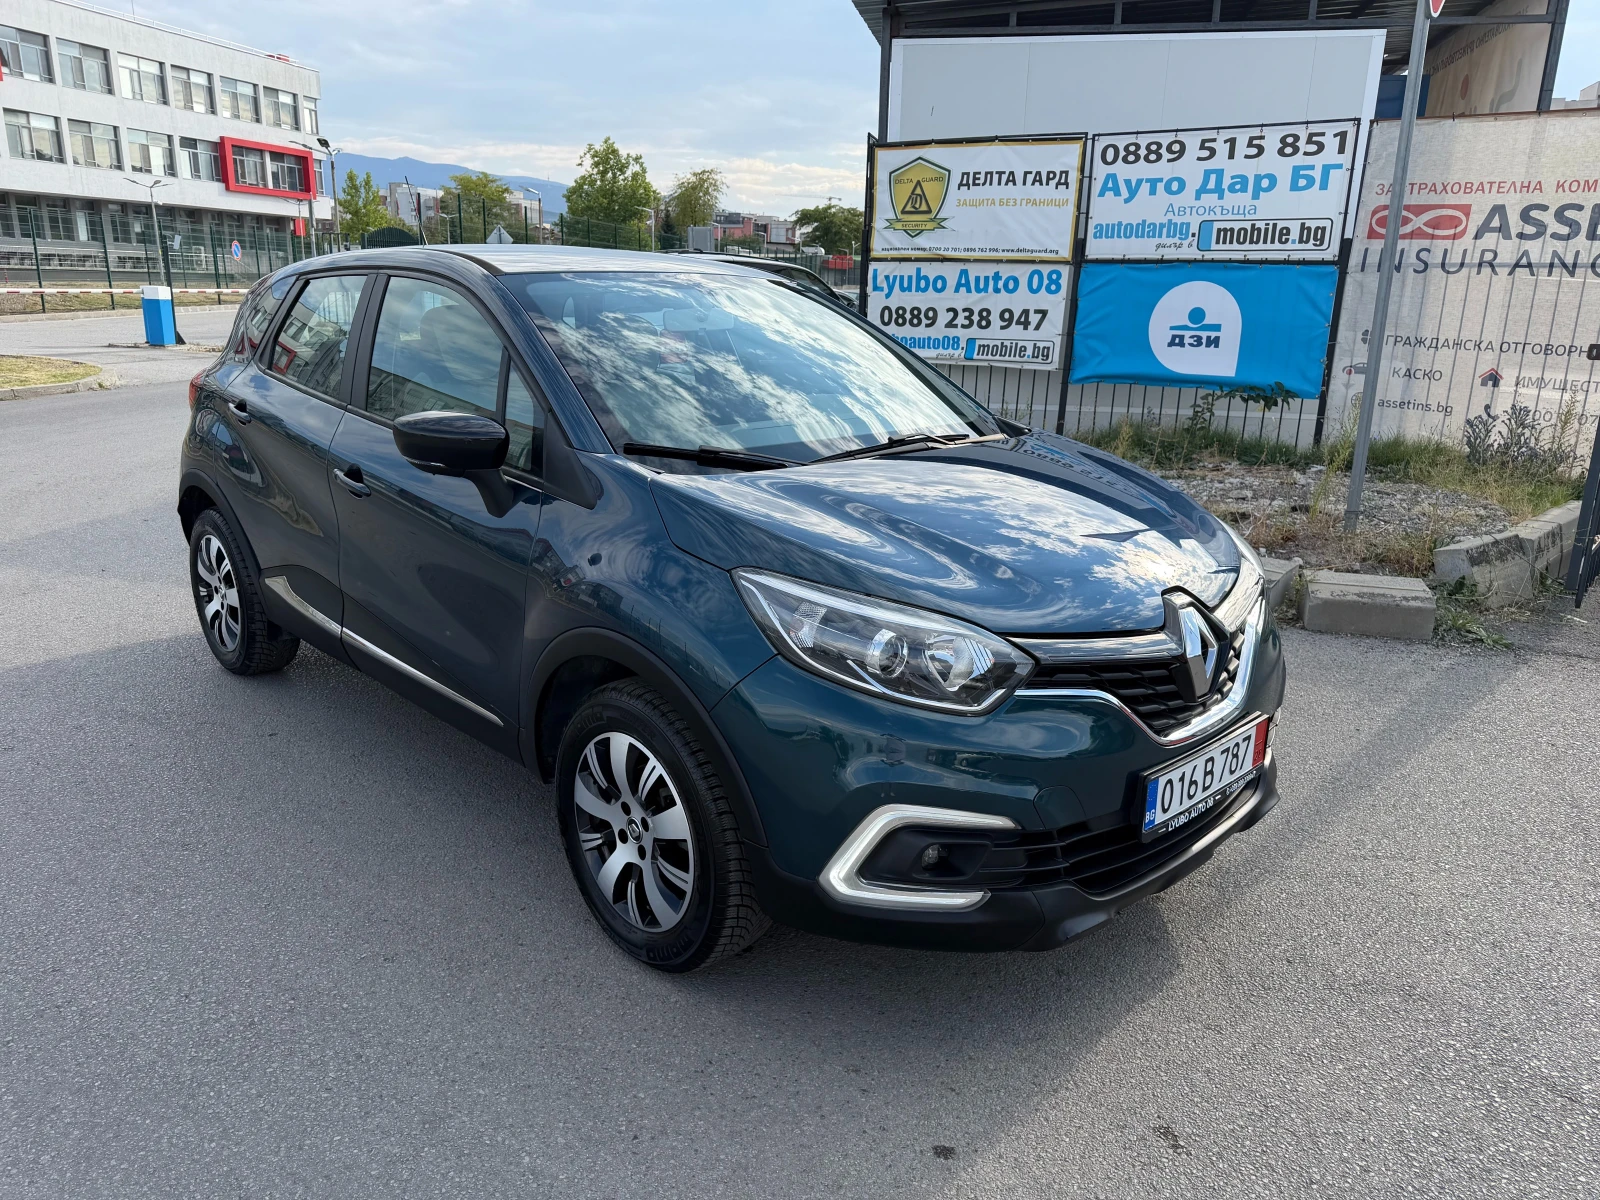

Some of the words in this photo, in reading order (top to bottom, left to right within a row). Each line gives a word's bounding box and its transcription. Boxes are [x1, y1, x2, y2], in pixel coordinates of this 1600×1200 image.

[1100, 140, 1187, 166] 0889
[1196, 135, 1266, 161] 515
[1277, 130, 1349, 156] 851
[958, 171, 1017, 190] ДЕЛТА
[1022, 170, 1070, 190] ГАРД
[1097, 172, 1187, 204] Ауто
[1195, 168, 1278, 200] Дар
[1289, 163, 1344, 192] БГ
[1375, 180, 1544, 196] ЗАТРАХОВАТЕЛНА
[956, 198, 997, 208] ЗАЩИТА
[999, 198, 1018, 207] БЕЗ
[1019, 198, 1069, 208] ГРАНИЦИ
[1164, 203, 1257, 218] Автокъща
[1215, 222, 1327, 247] mobile.bg
[872, 267, 947, 299] Lyubo
[954, 268, 1020, 294] Auto
[1027, 269, 1062, 295] 08
[879, 305, 938, 328] 0889
[944, 307, 992, 330] 238
[999, 309, 1049, 331] 947
[976, 340, 1051, 361] mobile.bg
[1167, 334, 1221, 349] ДЗИ
[1385, 334, 1495, 353] ГРАЖДАНСКА
[1392, 367, 1443, 382] КАСКО
[1378, 397, 1453, 417] assetins.bg
[1161, 734, 1252, 814] 016B787
[1145, 810, 1156, 824] BG
[1168, 813, 1189, 832] LYUBO
[1190, 802, 1207, 820] AUTO
